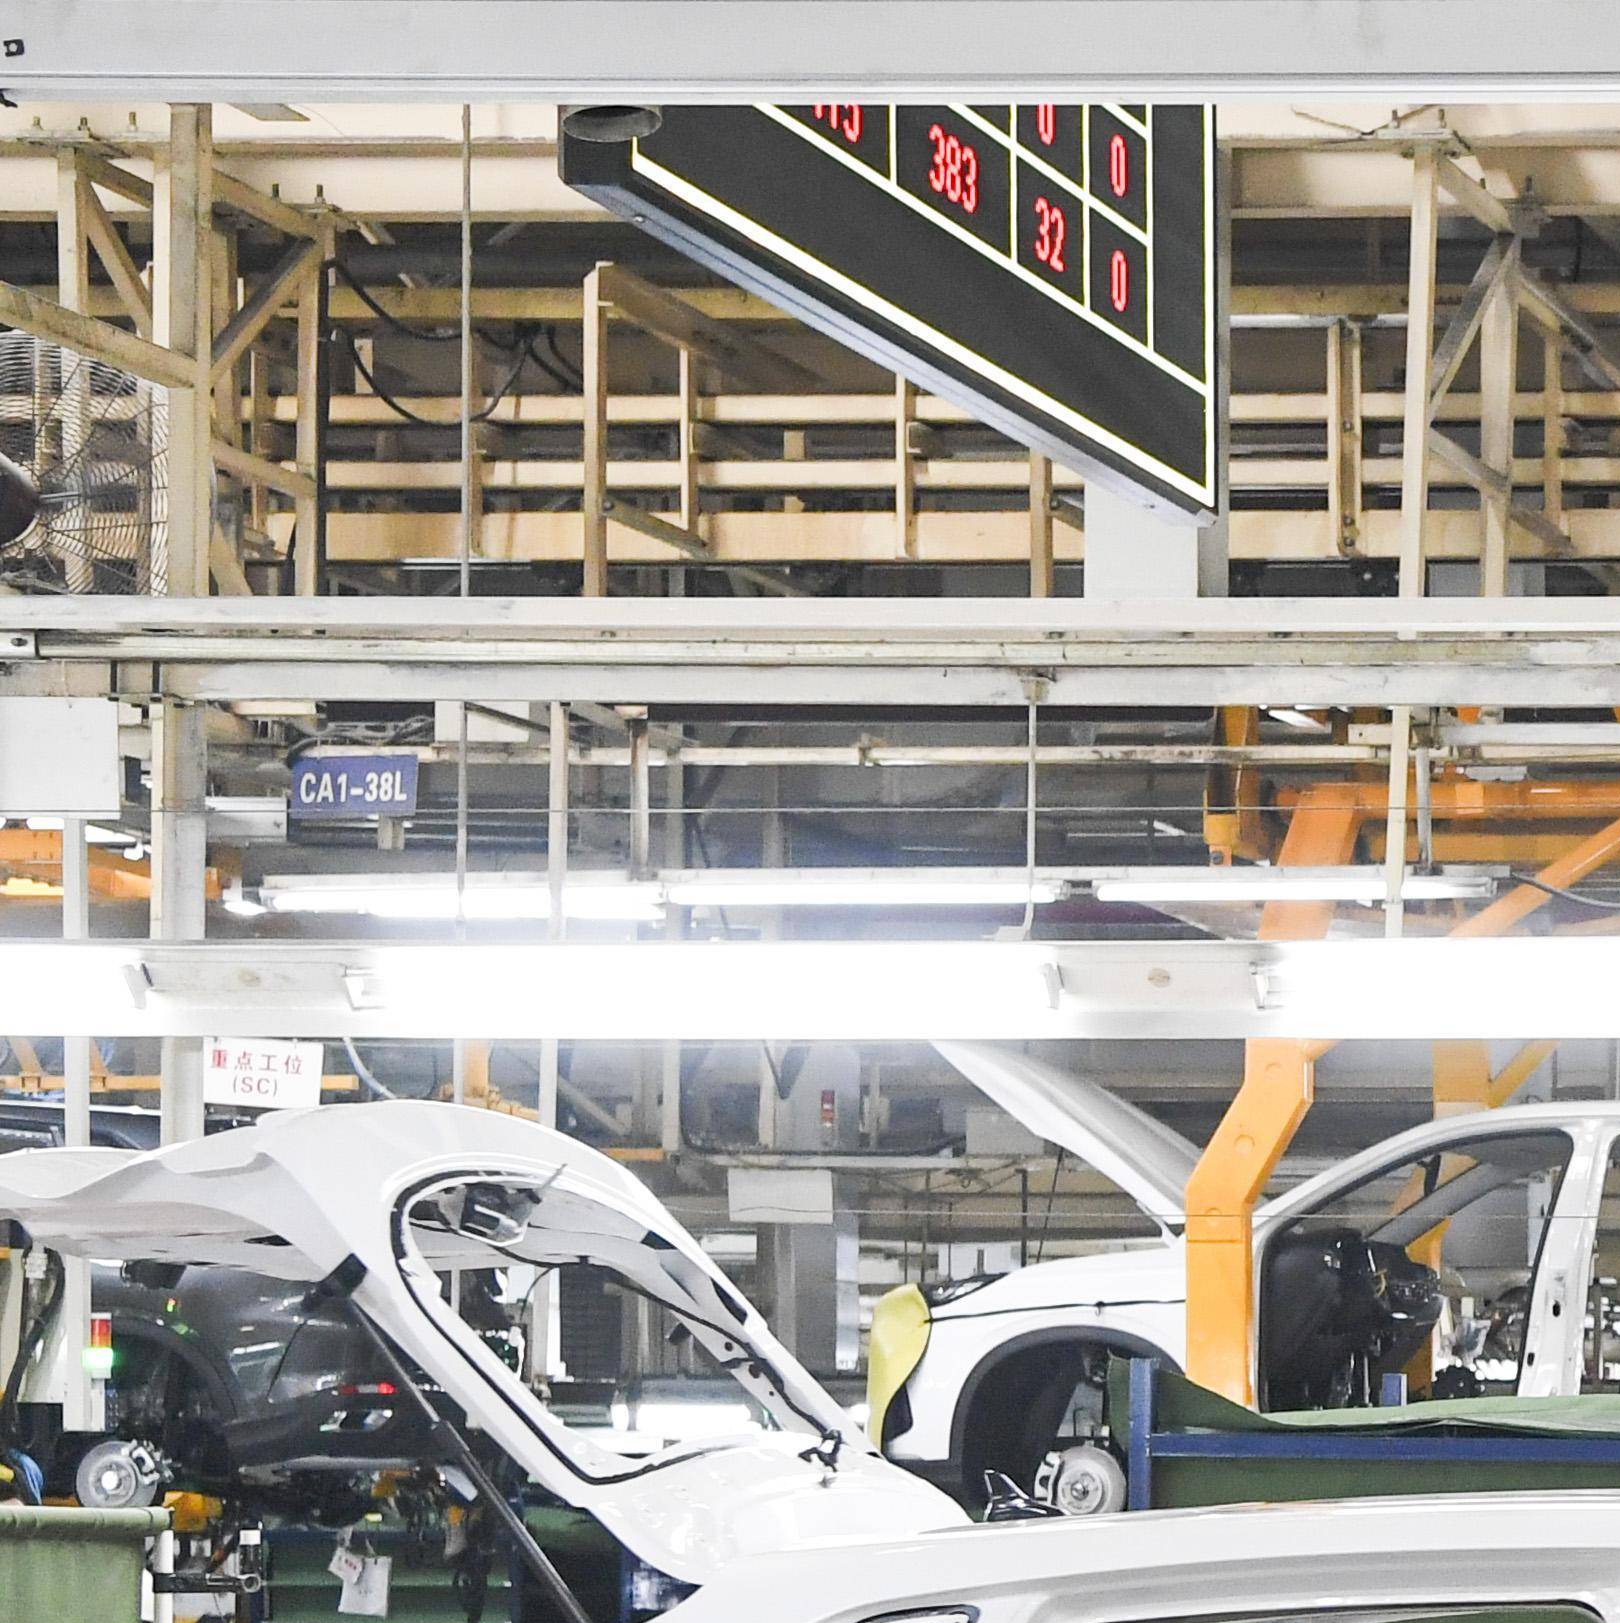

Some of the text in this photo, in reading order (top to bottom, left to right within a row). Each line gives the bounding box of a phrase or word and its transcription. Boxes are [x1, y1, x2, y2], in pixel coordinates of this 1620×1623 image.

[928, 122, 979, 214] 383
[1109, 133, 1128, 197] 0
[1033, 196, 1065, 273] 32
[1110, 250, 1129, 313] 0
[299, 770, 408, 804] CA1-38L
[211, 1048, 303, 1076] 重点工位
[232, 1075, 278, 1097] (SC)
